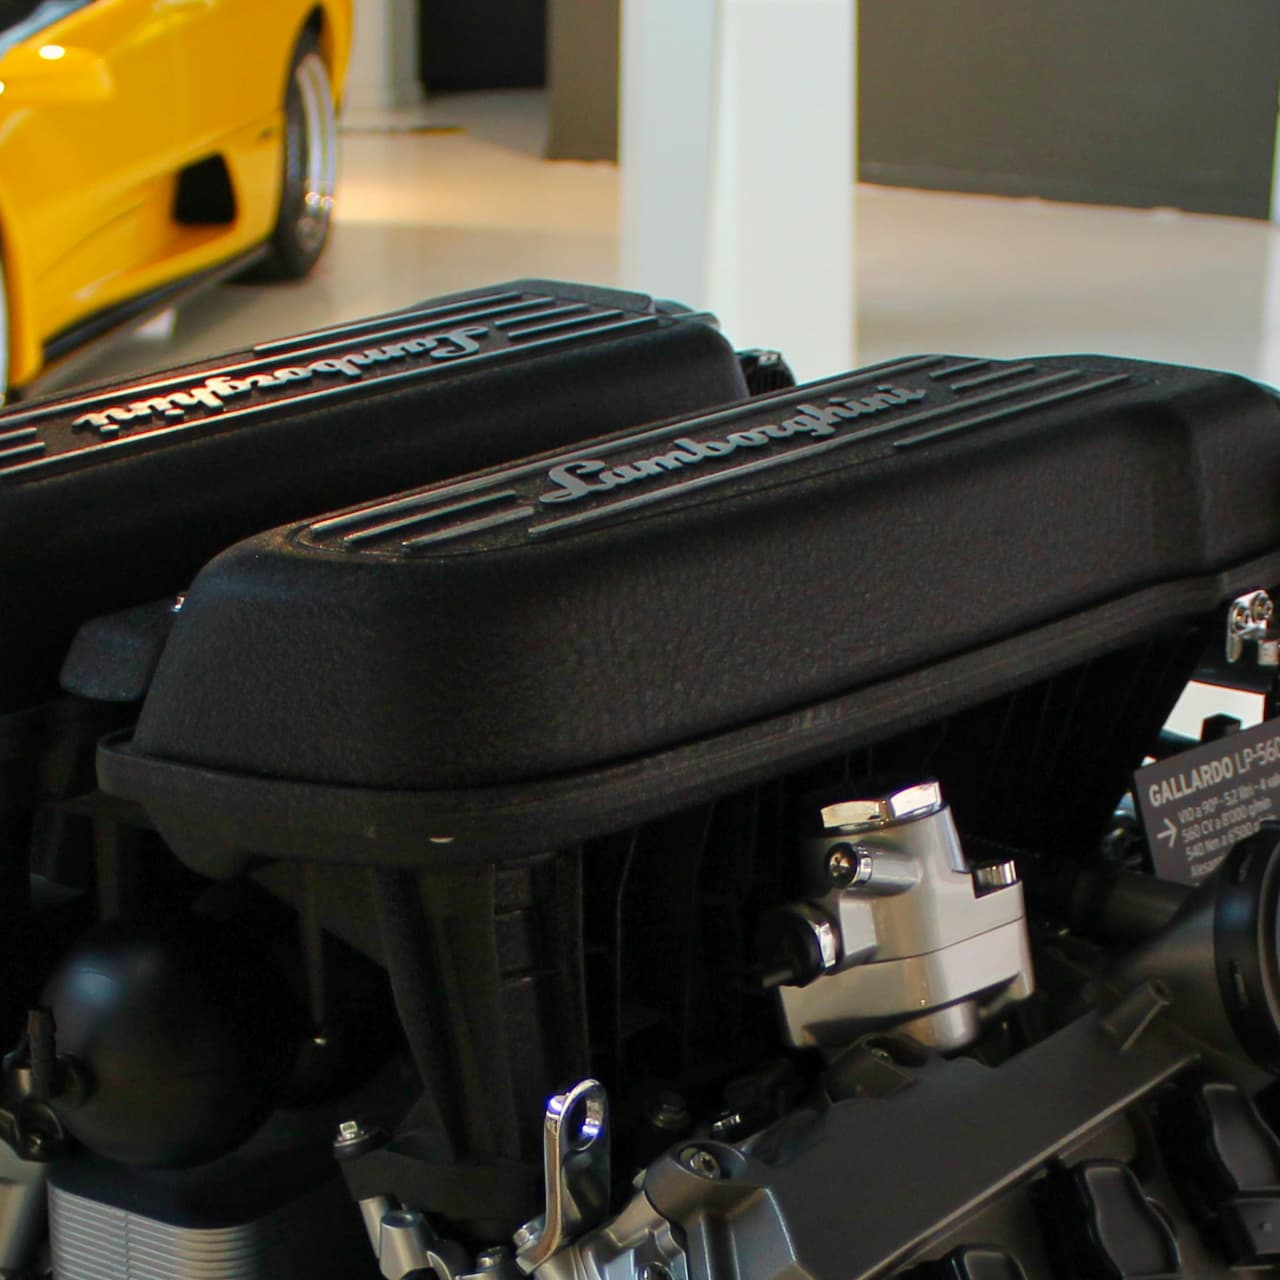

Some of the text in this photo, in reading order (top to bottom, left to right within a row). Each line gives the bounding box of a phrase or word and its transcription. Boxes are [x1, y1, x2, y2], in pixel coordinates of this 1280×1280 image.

[72, 324, 489, 433] Lamborghini
[539, 384, 926, 504] Lamborghini
[1148, 756, 1234, 807] GALLARDO
